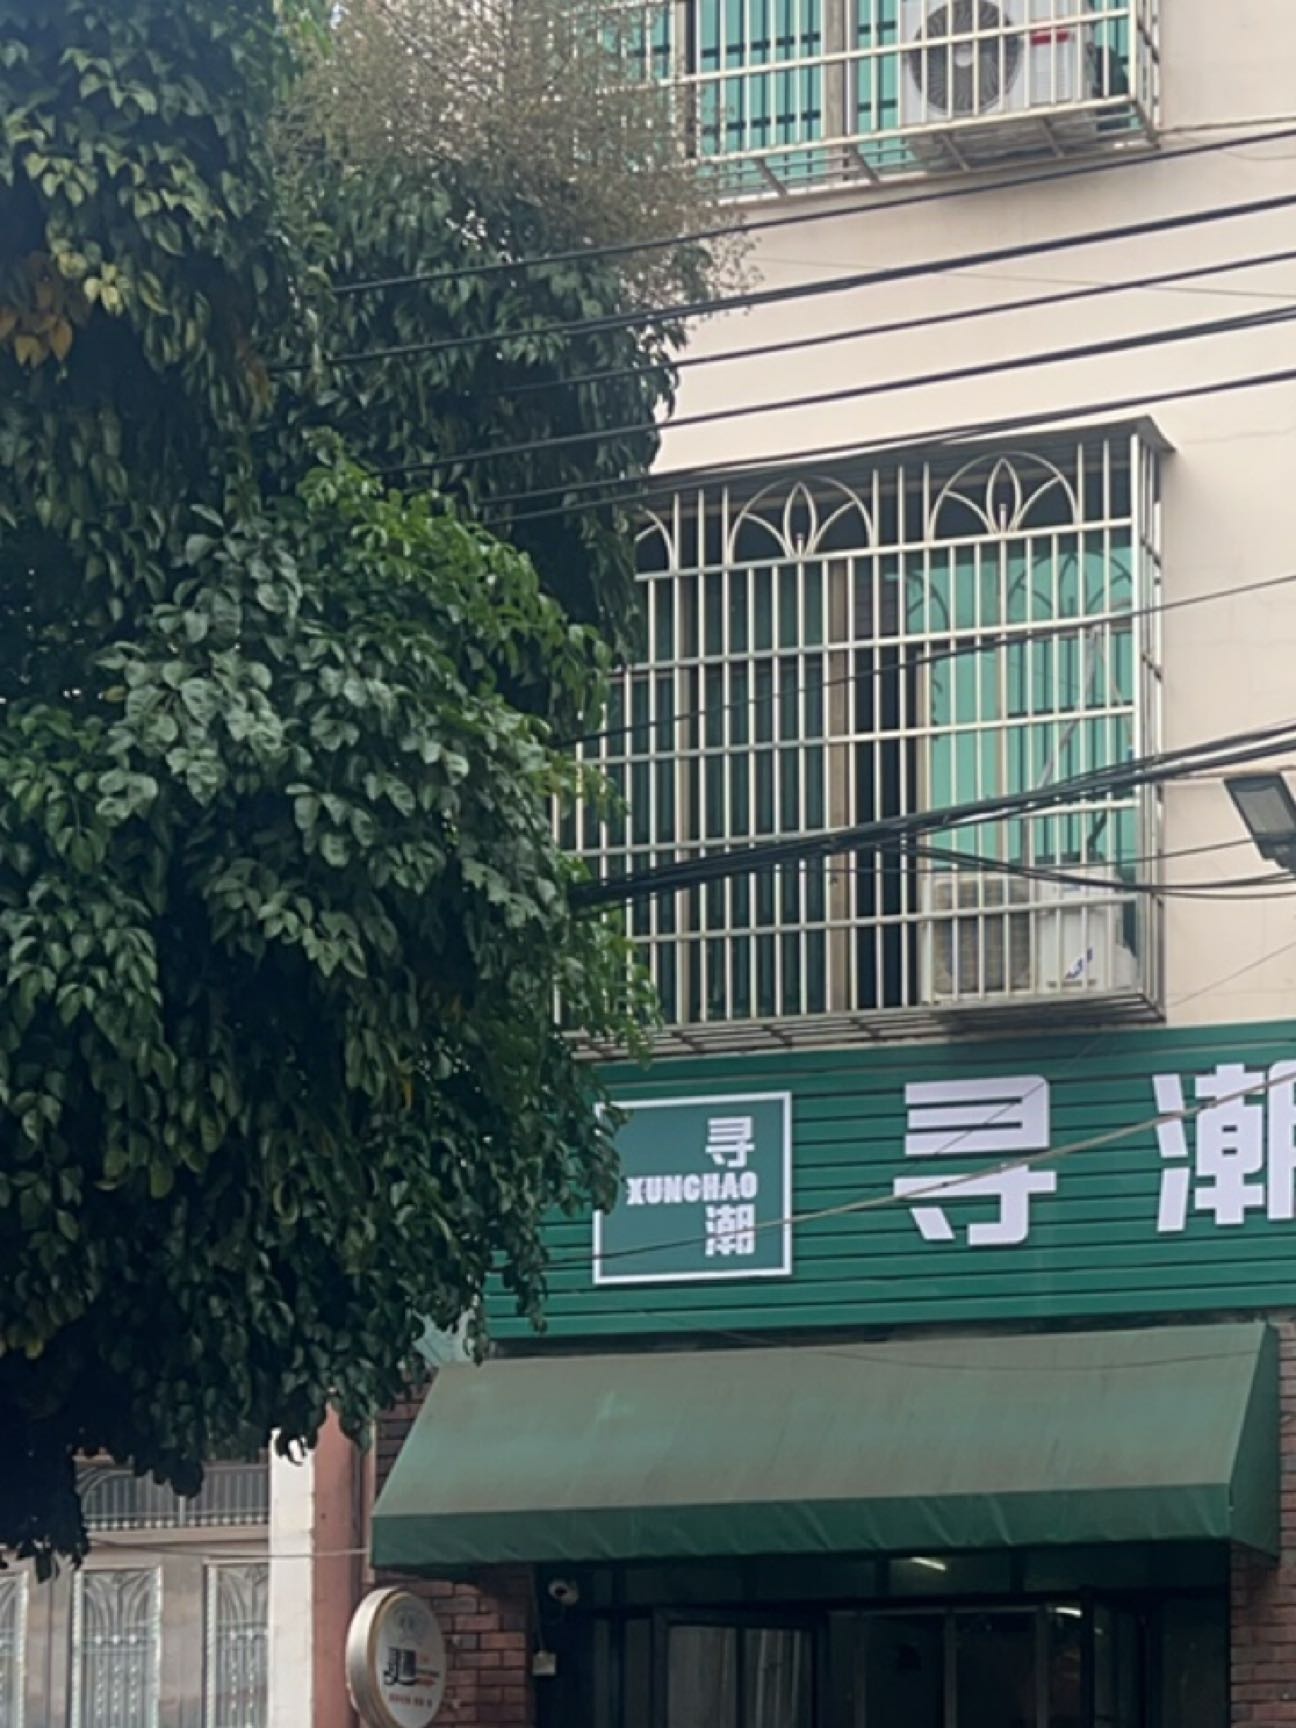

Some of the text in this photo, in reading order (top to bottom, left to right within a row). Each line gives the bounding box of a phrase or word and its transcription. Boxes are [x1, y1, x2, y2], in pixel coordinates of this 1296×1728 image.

[705, 1116, 755, 1168] 寻
[626, 1171, 758, 1206] XUNCHAO
[705, 1204, 755, 1256] 潮
